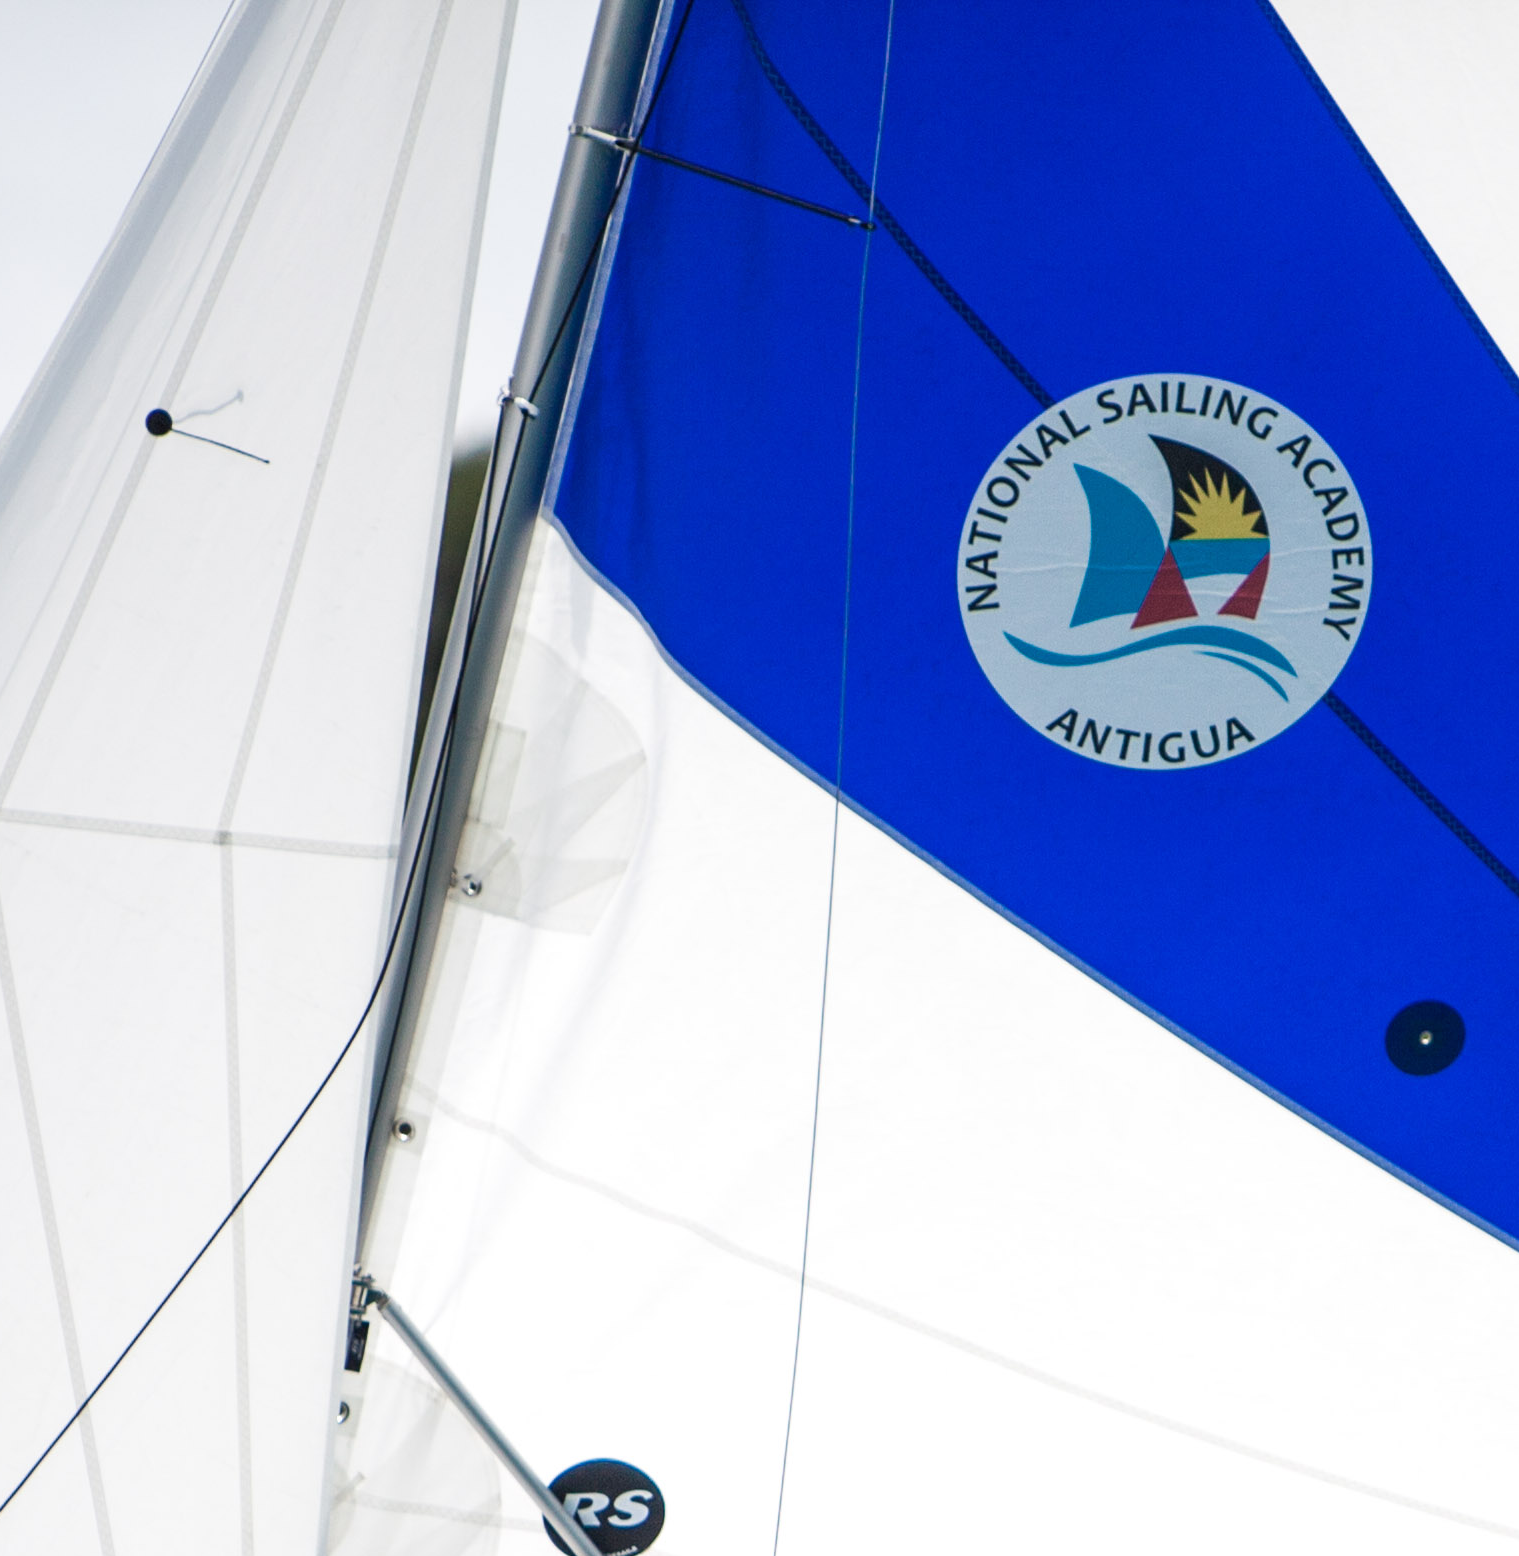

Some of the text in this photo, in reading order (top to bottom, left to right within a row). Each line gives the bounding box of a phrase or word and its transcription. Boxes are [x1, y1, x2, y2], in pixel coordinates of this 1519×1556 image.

[965, 381, 1365, 641] NATIONAL SAILING ACADEMY
[1045, 708, 1256, 763] ANTIGUA
[563, 1489, 654, 1527] RS
